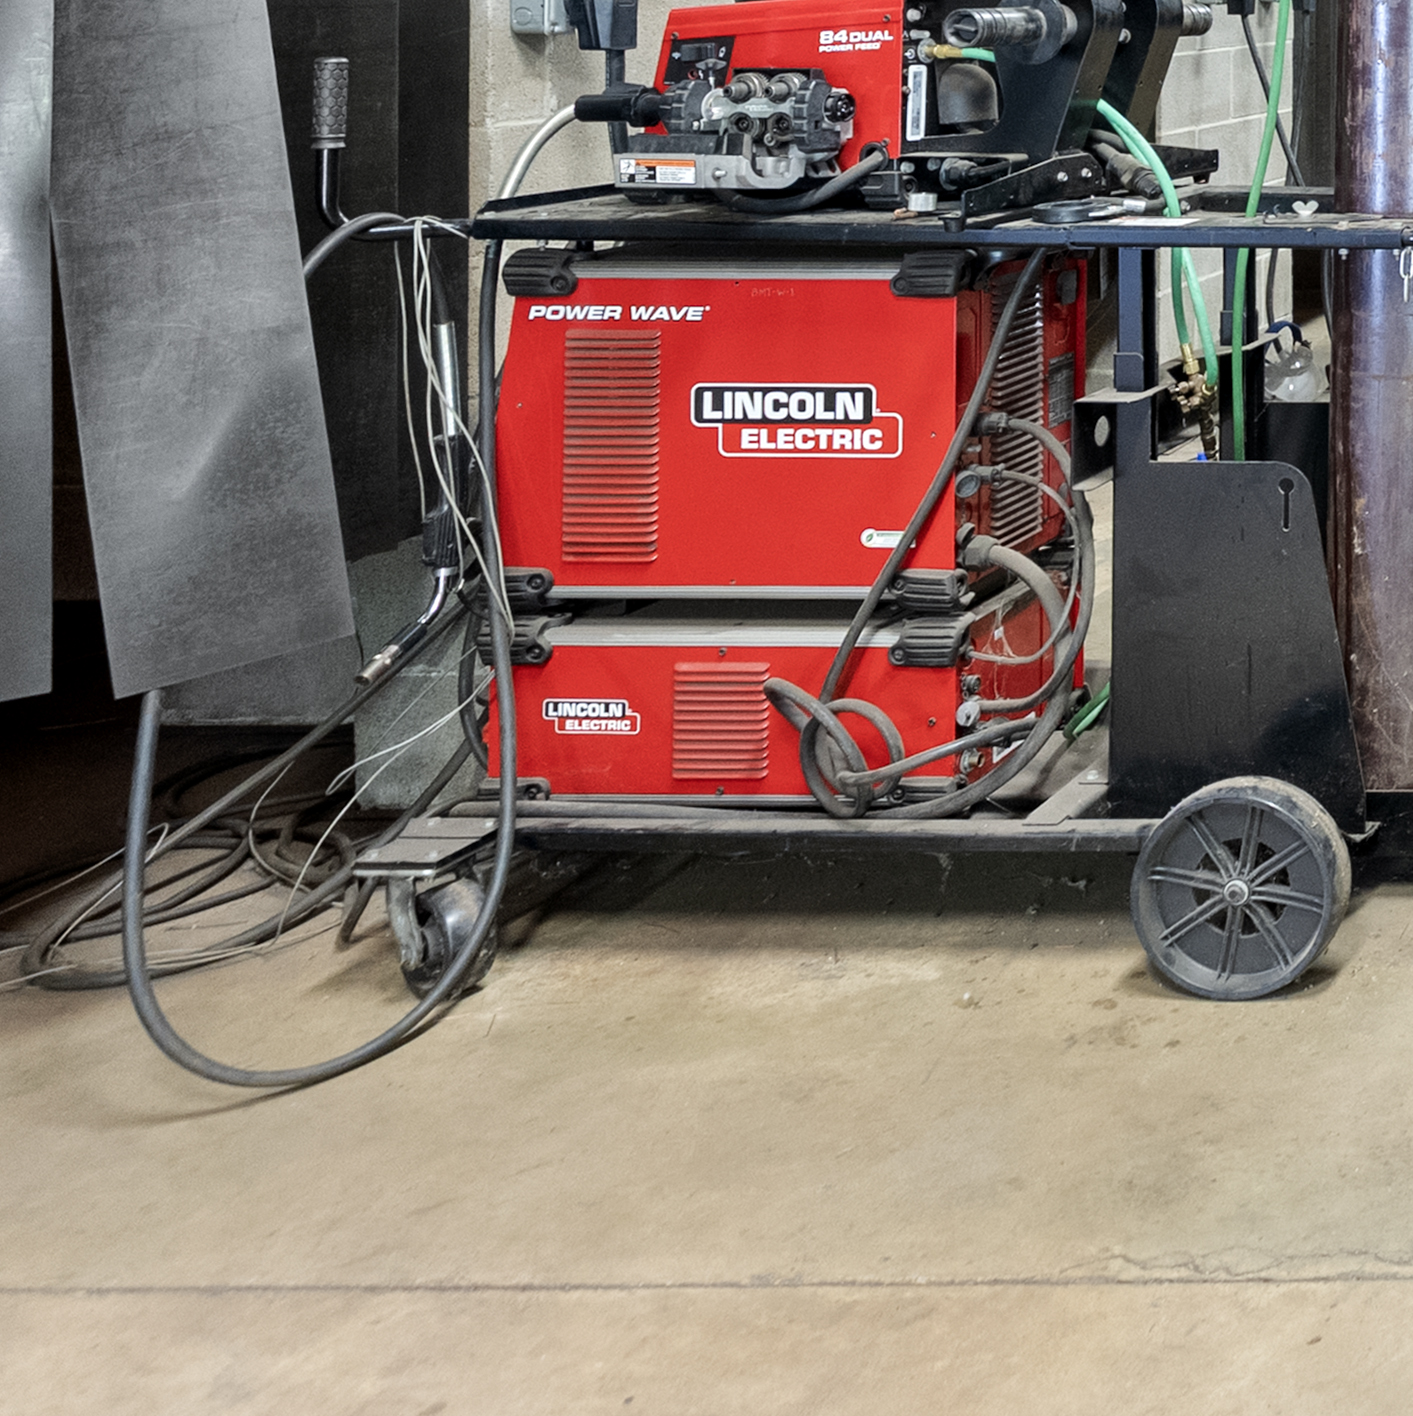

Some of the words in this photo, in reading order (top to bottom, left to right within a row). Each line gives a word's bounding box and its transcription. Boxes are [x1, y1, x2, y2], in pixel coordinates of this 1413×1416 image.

[819, 29, 848, 45] 84
[849, 29, 894, 43] DUAL
[818, 44, 854, 54] POWER
[855, 42, 881, 51] FEED
[528, 305, 623, 321] POWER
[629, 305, 706, 322] WAVE
[702, 390, 865, 420] LINCOLN
[740, 428, 884, 451] ELECTRIC
[547, 702, 623, 718] LINCOLN
[564, 719, 632, 731] ELECTRIC
